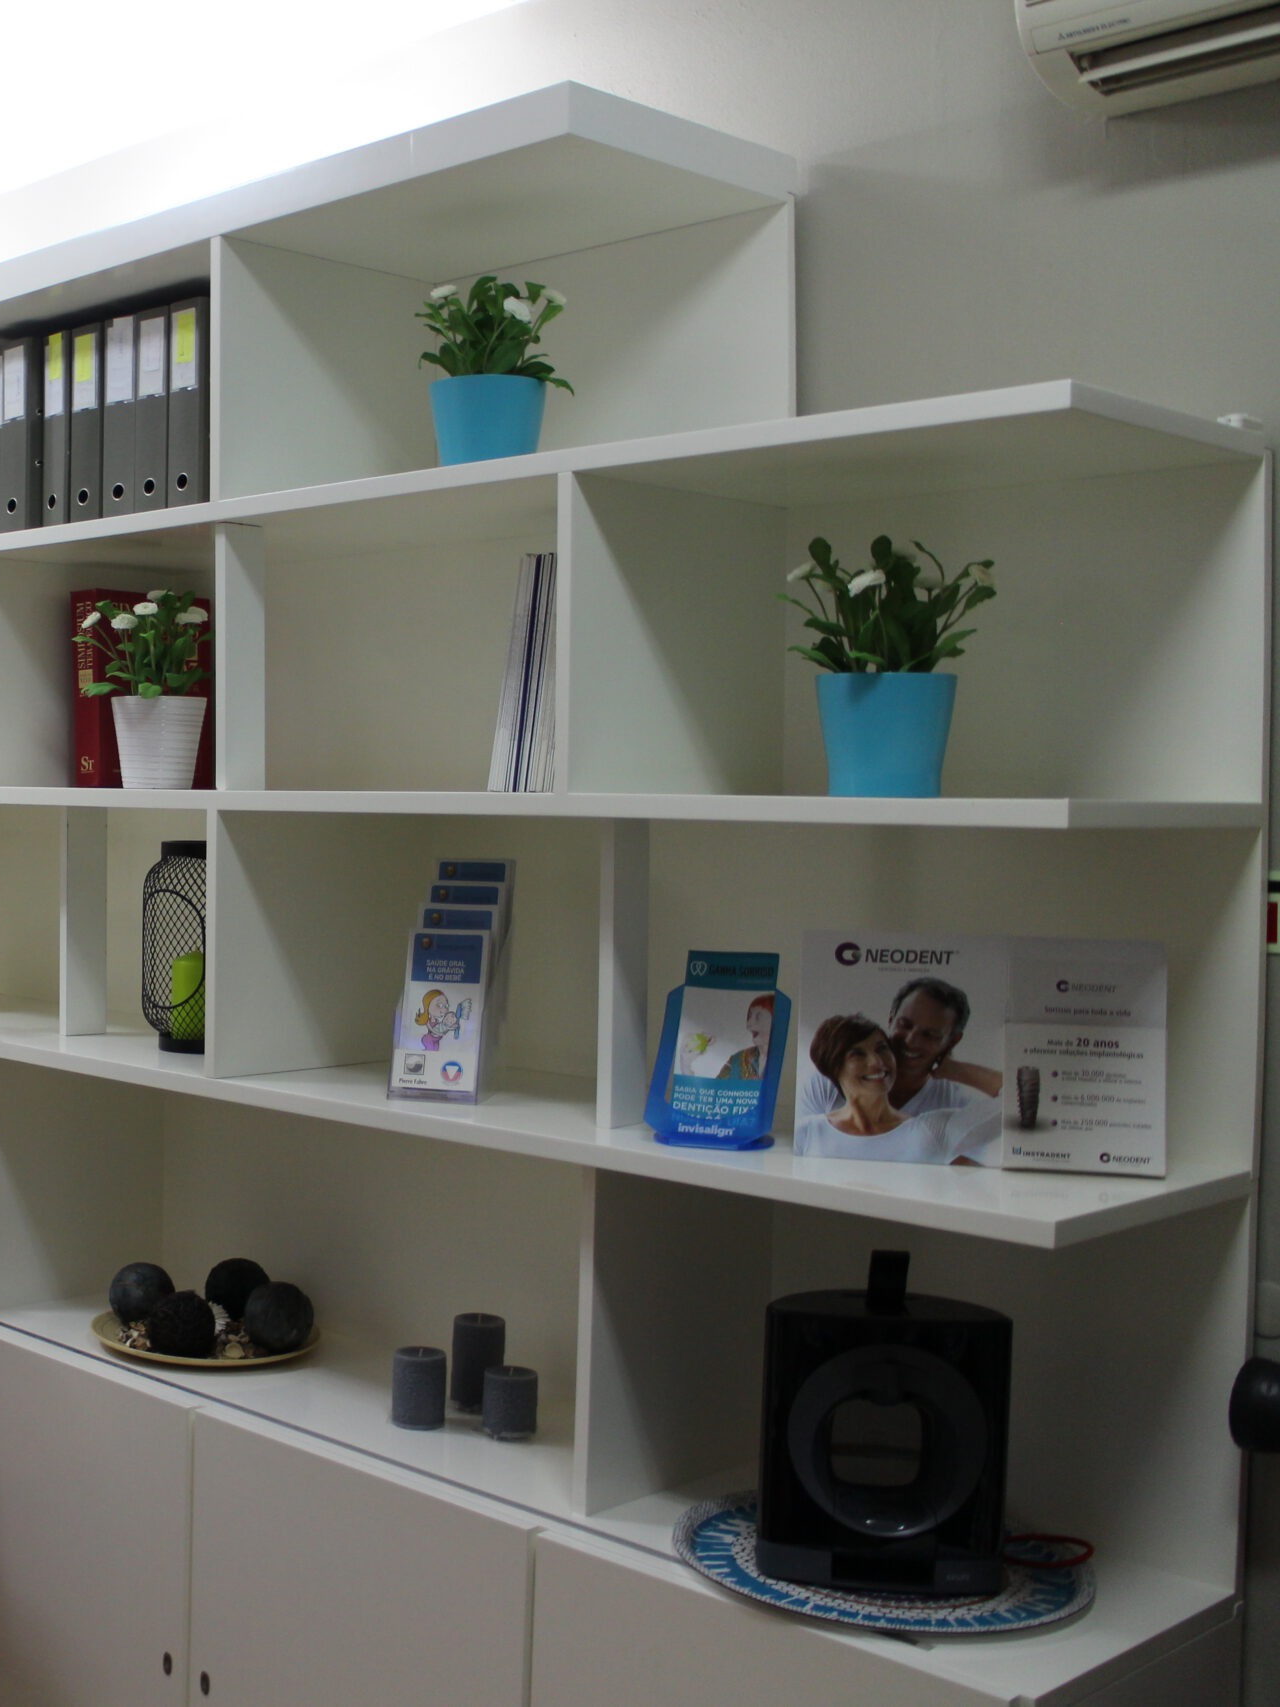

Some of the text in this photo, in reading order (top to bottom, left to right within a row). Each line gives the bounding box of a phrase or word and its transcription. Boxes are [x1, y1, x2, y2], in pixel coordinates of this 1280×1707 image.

[865, 948, 954, 965] NEODENT
[1071, 983, 1117, 992] NEODENT
[1076, 1037, 1090, 1047] 20
[1093, 1039, 1119, 1049] anos
[674, 1085, 697, 1093] SABIA
[699, 1088, 715, 1096] QUE
[673, 1092, 696, 1101] PODE
[699, 1095, 713, 1103] TER
[672, 1101, 729, 1115] DENTIÇÃO
[678, 1122, 734, 1137] invisalign
[1112, 1156, 1151, 1164] NEODENT
